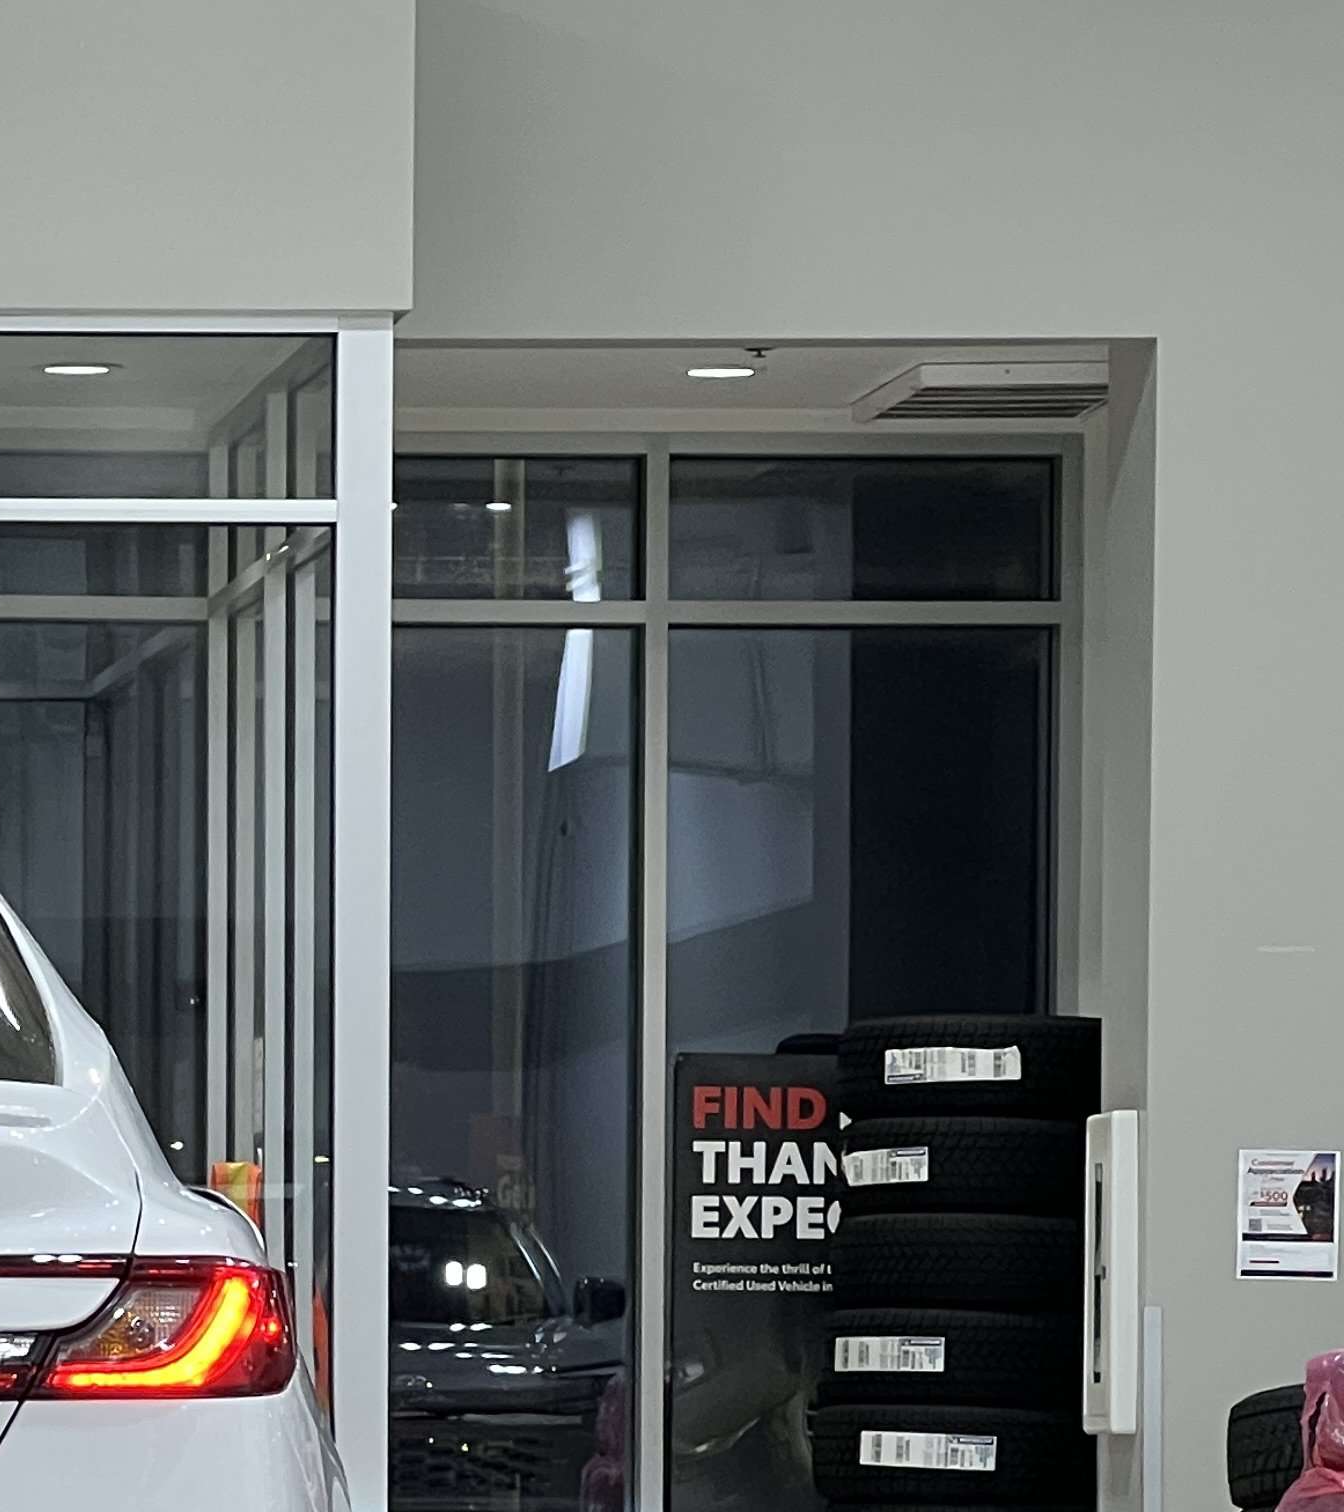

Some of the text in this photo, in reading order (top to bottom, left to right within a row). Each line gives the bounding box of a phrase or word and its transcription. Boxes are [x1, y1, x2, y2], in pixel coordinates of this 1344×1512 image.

[693, 1085, 828, 1130] FIND
[692, 1140, 838, 1185] THAN
[693, 1262, 758, 1275] Experience
[760, 1264, 779, 1275] the
[782, 1264, 810, 1275] thrill
[812, 1263, 825, 1275] of
[693, 1279, 745, 1292] Certified
[746, 1280, 776, 1292] Used
[778, 1280, 820, 1292] Vehicle
